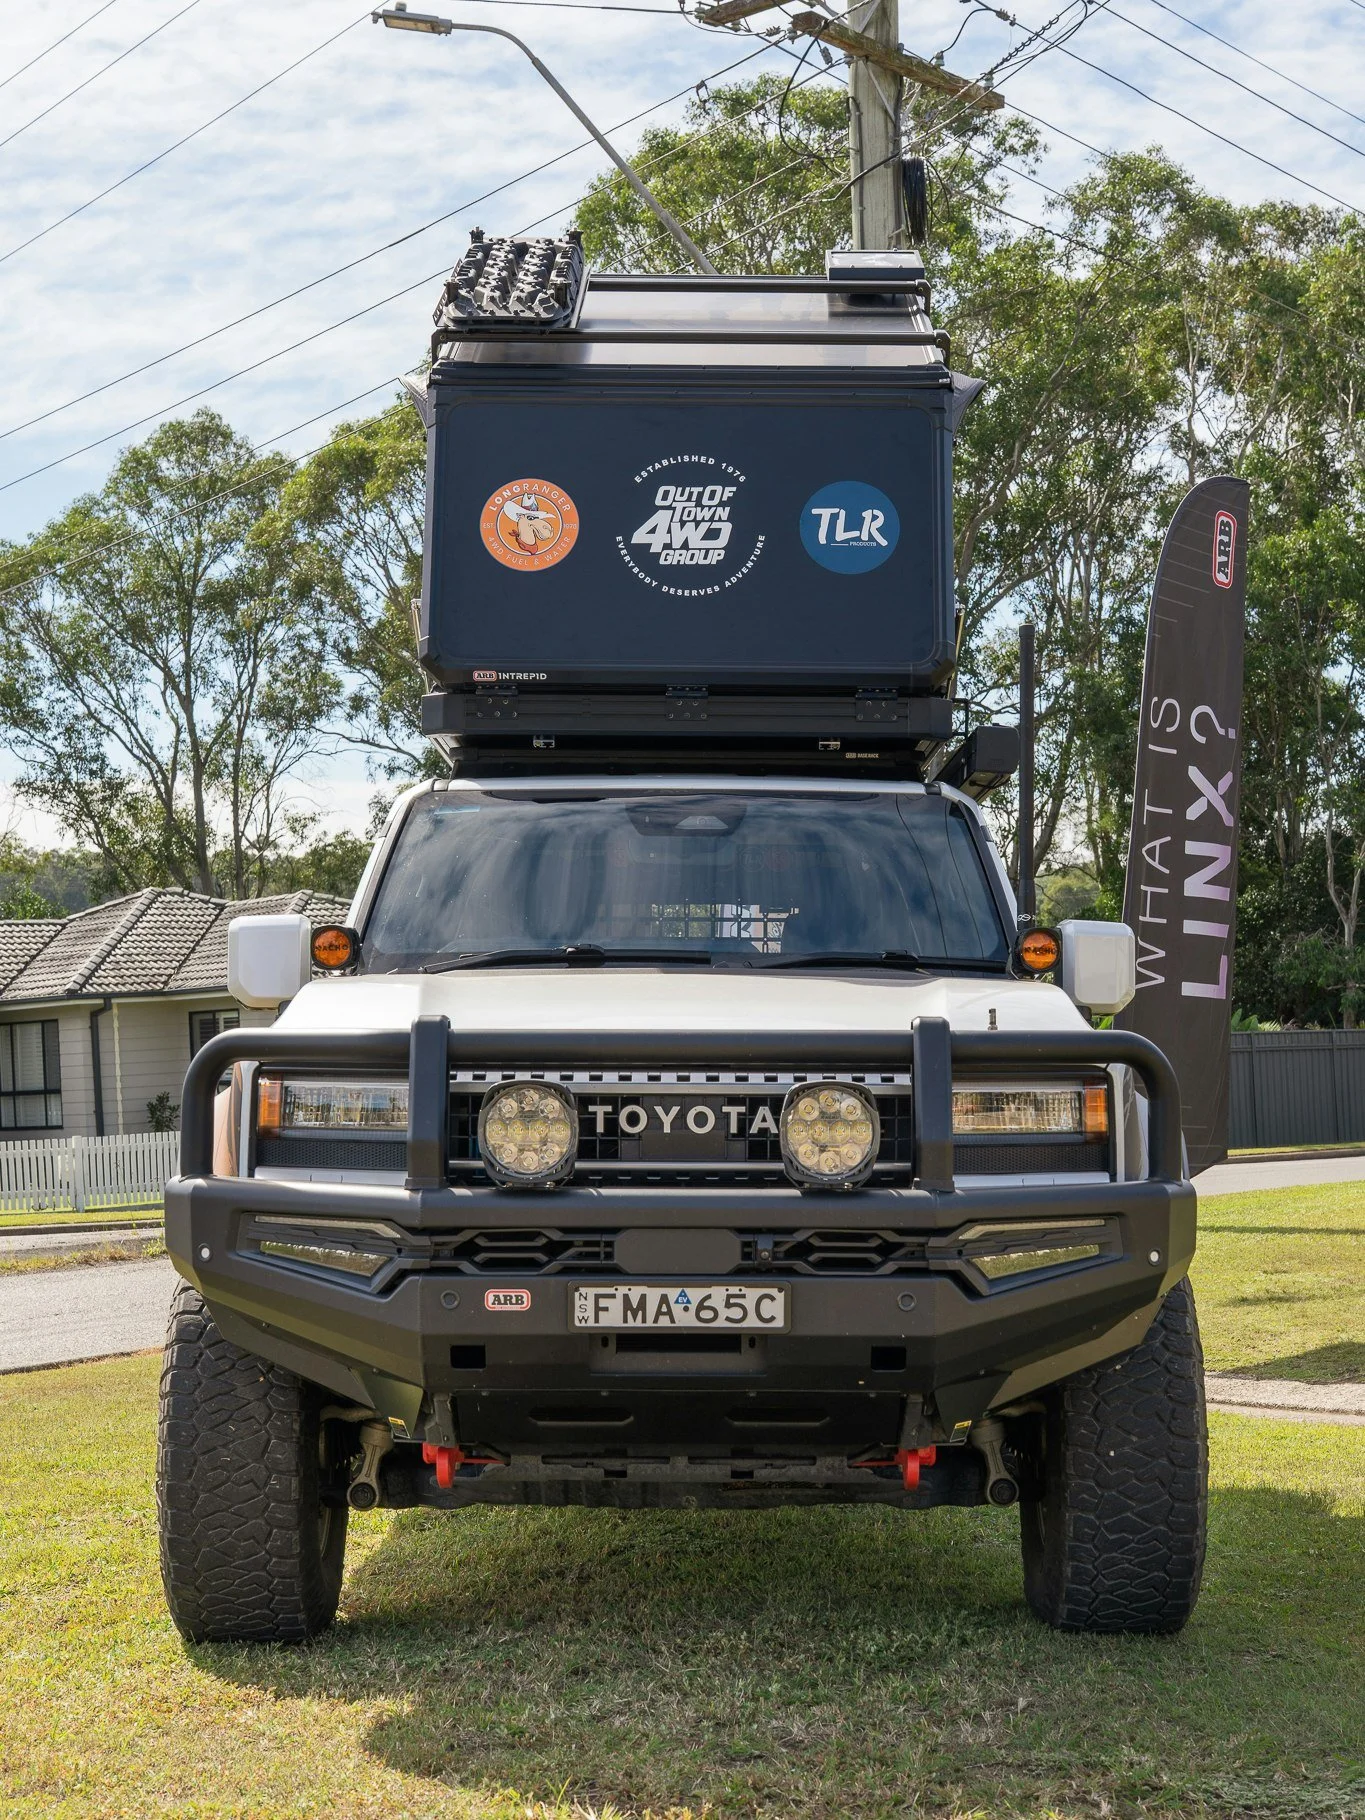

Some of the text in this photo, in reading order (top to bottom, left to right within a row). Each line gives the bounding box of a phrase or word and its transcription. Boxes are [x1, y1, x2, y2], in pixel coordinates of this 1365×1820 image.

[634, 454, 747, 484] ESTABLISHED 1976
[489, 483, 571, 512] LONGRANGER
[671, 501, 730, 523] TOWN
[630, 509, 733, 553] 4WD
[811, 507, 889, 547] TLR
[488, 536, 571, 566] 4WD FUEL & WATER
[659, 549, 726, 565] GROUP
[1216, 518, 1230, 581] ARB
[616, 534, 766, 597] EVERYBODY DESERVES ADVENTURE
[497, 672, 548, 680] INTREPID
[1135, 696, 1181, 990] WHAT IS
[1181, 705, 1237, 1000] LINX?
[588, 1104, 779, 1135] TOYOTA
[491, 1294, 525, 1306] ARB
[678, 1296, 689, 1304] EV
